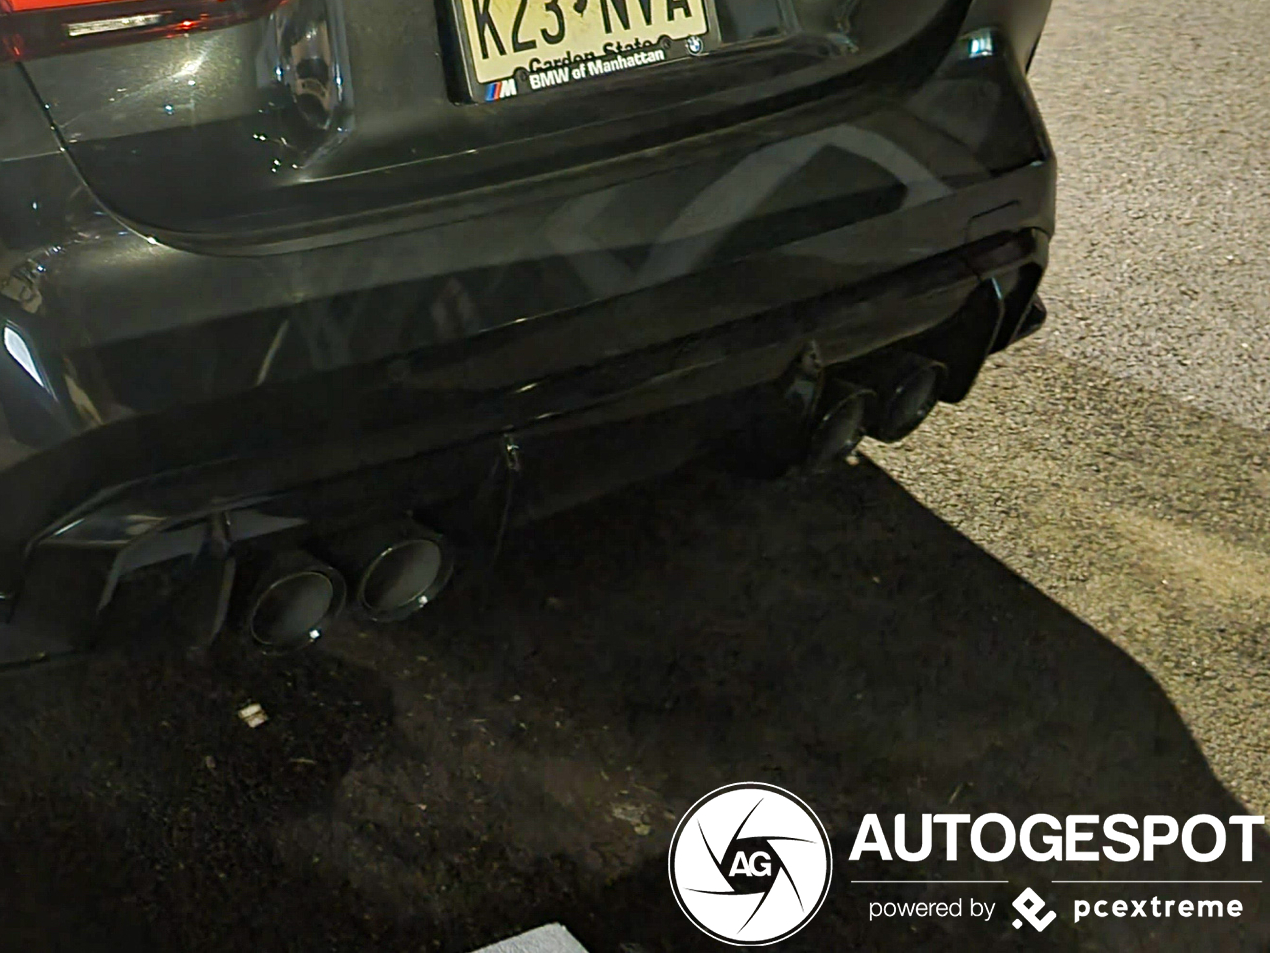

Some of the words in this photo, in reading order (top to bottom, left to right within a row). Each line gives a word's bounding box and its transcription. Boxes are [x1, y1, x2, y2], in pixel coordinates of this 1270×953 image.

[529, 69, 570, 91] BMW
[571, 64, 587, 80] of
[586, 49, 666, 77] Manhattan
